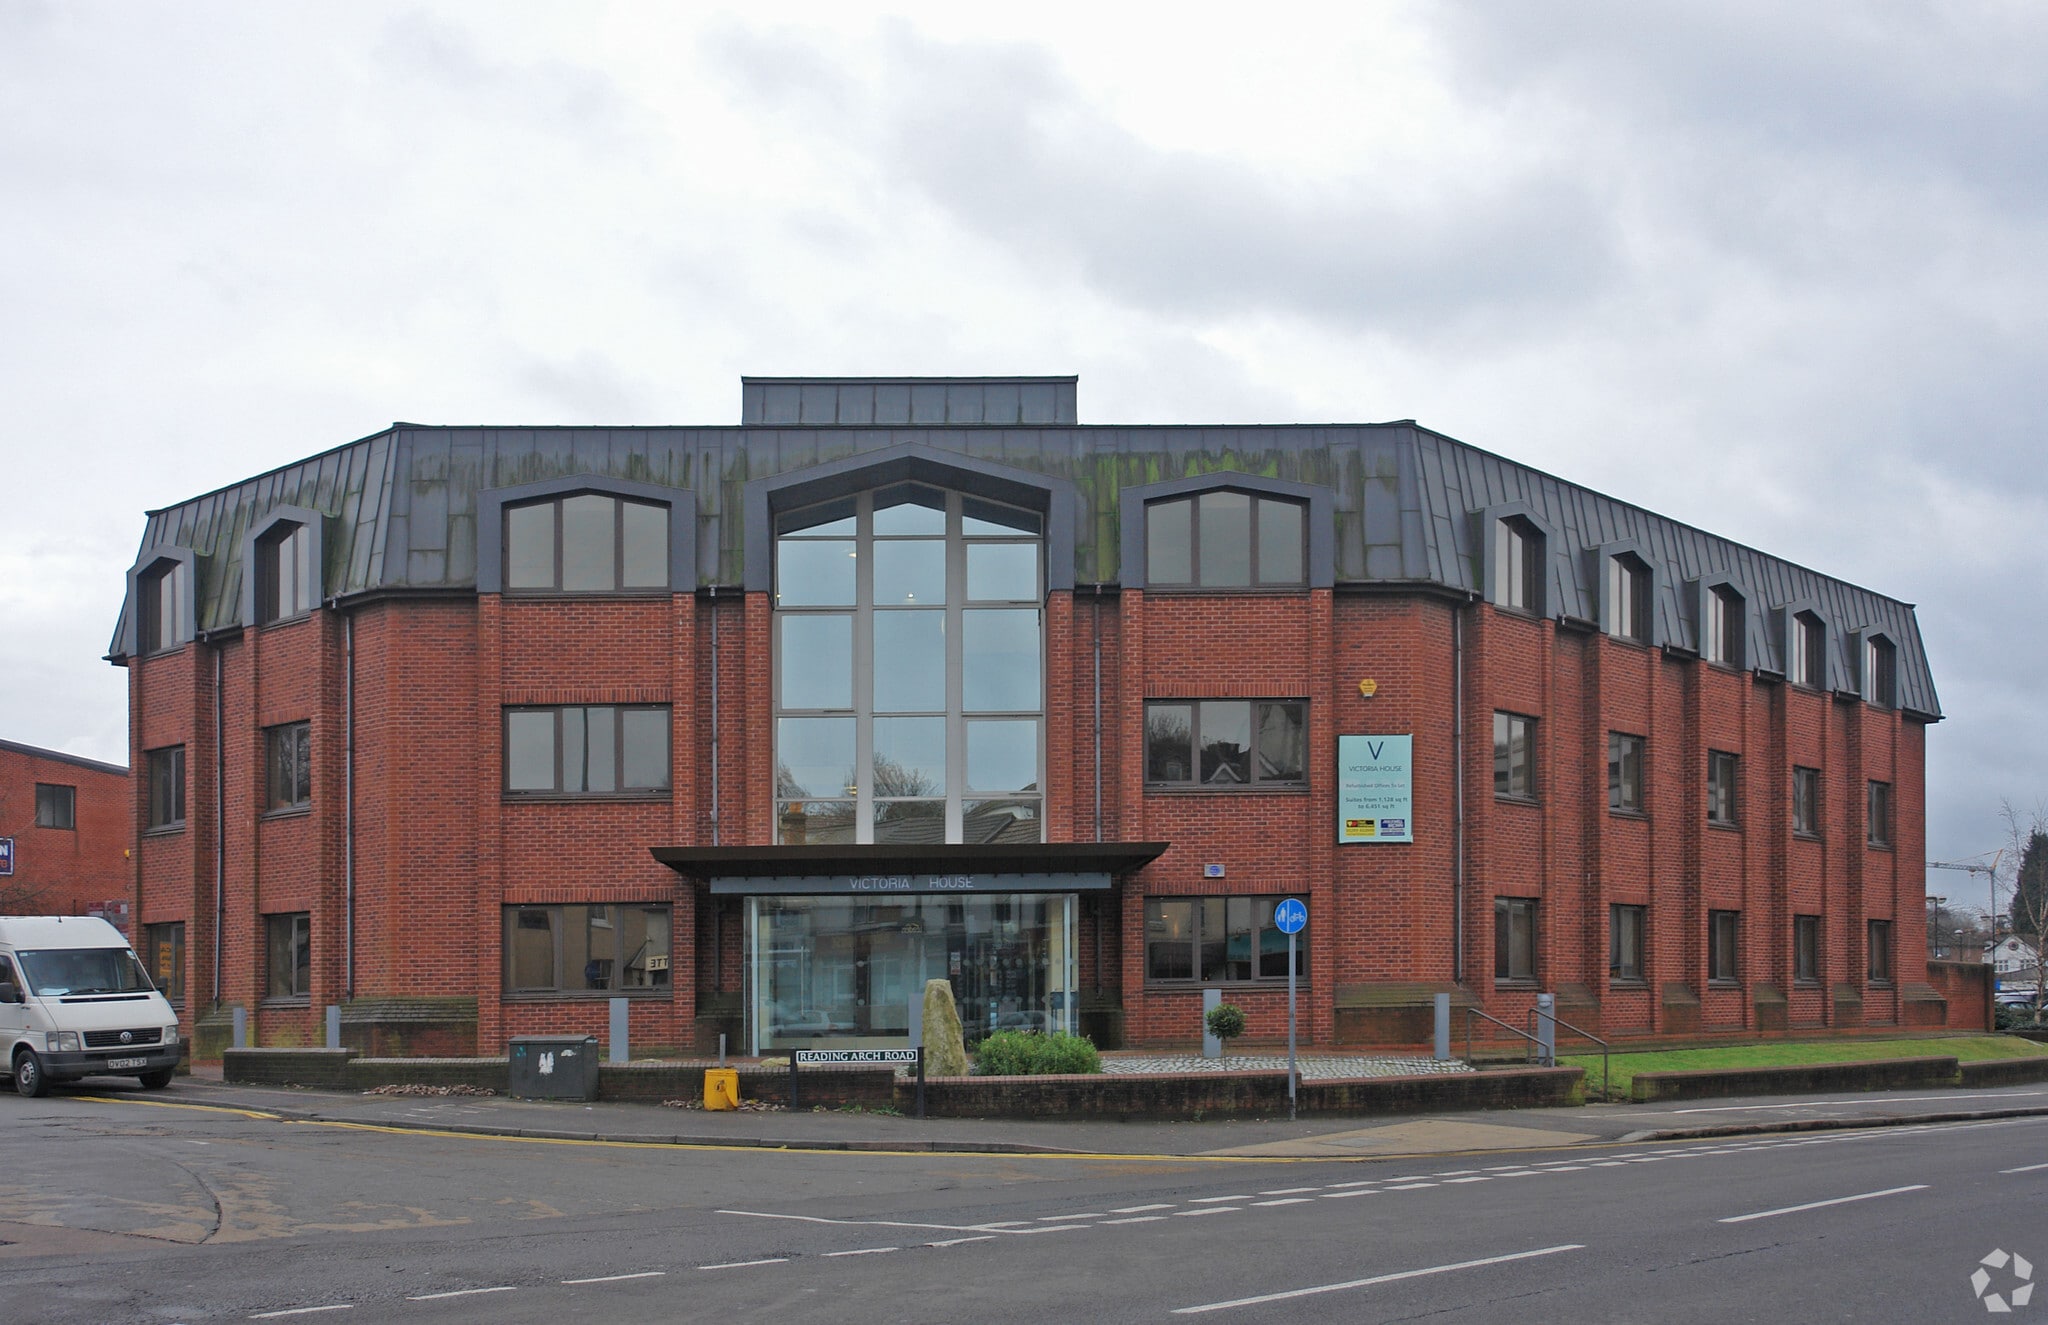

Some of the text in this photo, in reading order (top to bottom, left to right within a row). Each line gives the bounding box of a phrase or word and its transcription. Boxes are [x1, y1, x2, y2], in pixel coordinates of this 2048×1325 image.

[849, 876, 974, 889] VICTORIA HOUSE
[800, 1051, 914, 1062] READING ARCH ROAD
